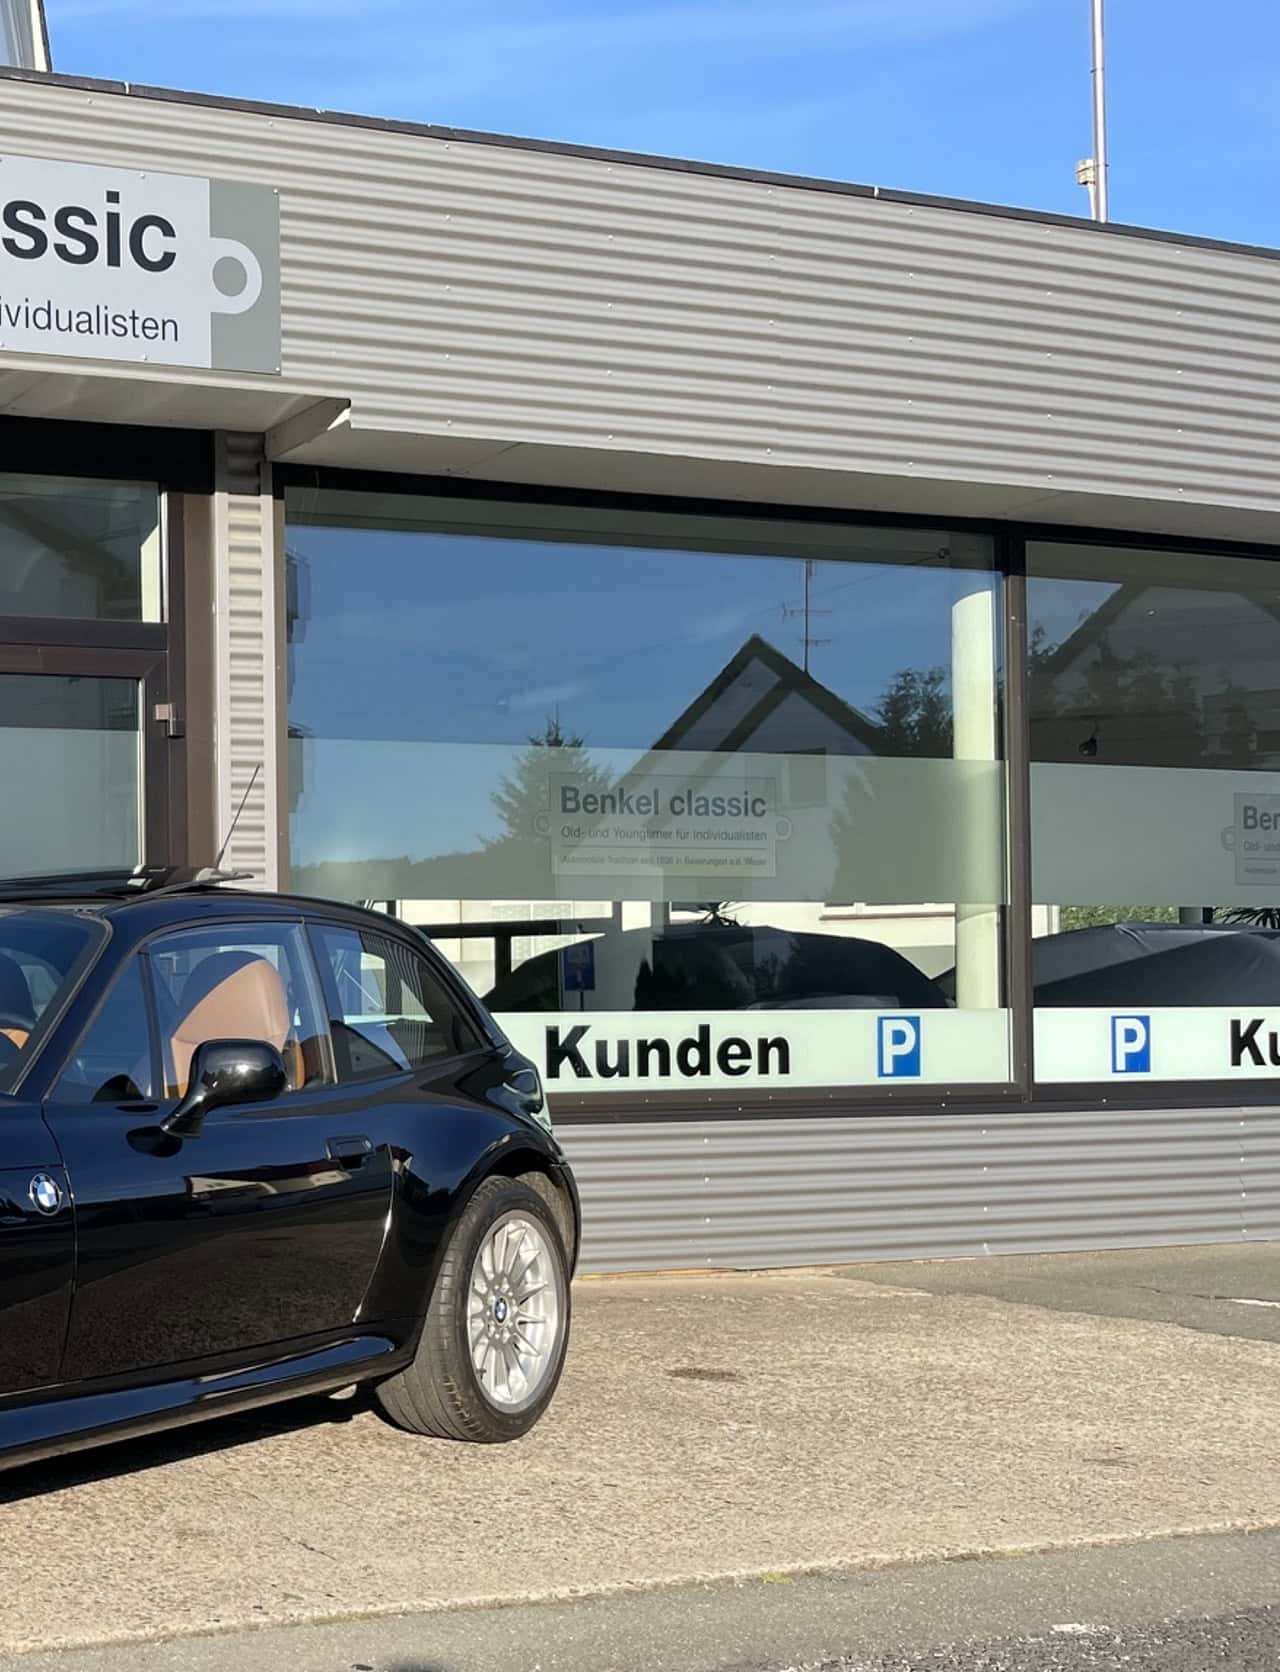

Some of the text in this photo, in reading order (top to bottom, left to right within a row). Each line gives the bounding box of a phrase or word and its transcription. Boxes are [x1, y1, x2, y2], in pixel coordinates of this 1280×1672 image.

[560, 786, 767, 817] Benkel classic
[545, 1019, 917, 1079] Kunden P
[1115, 1018, 1147, 1072] P
